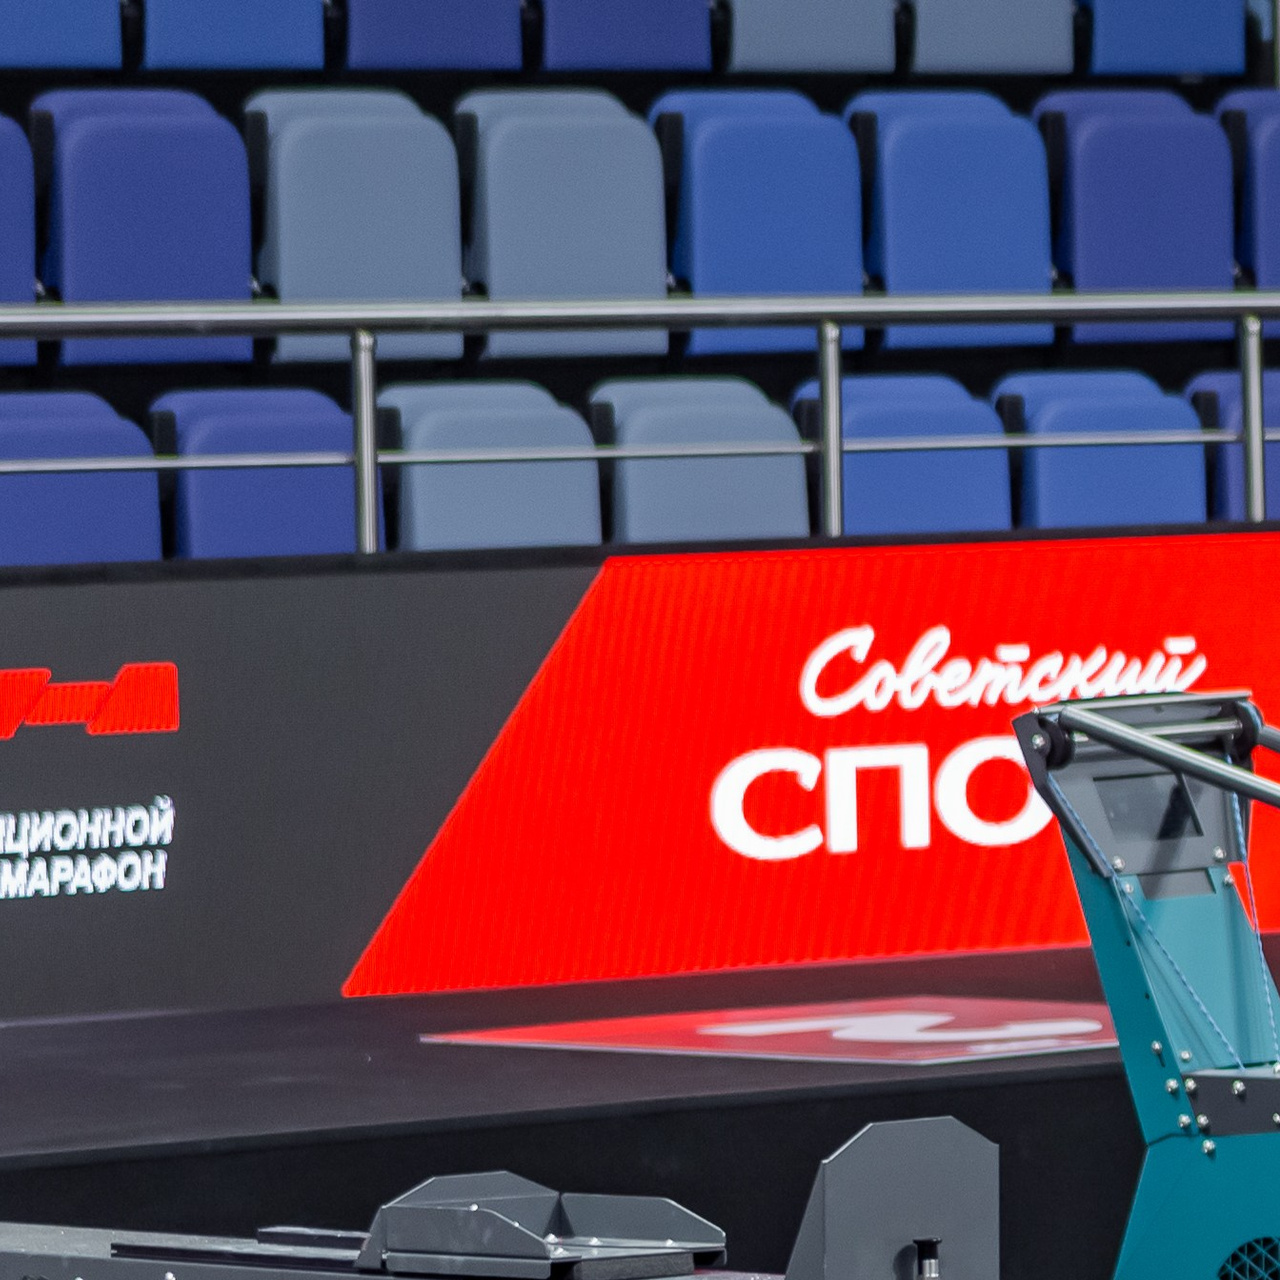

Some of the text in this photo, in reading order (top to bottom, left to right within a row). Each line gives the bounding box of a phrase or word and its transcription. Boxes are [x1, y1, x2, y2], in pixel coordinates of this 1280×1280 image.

[802, 625, 1207, 719] Советский
[0, 795, 175, 858] ЦИОННОЙ
[710, 735, 1056, 861] СПО
[0, 849, 167, 899] МАРАФОН
